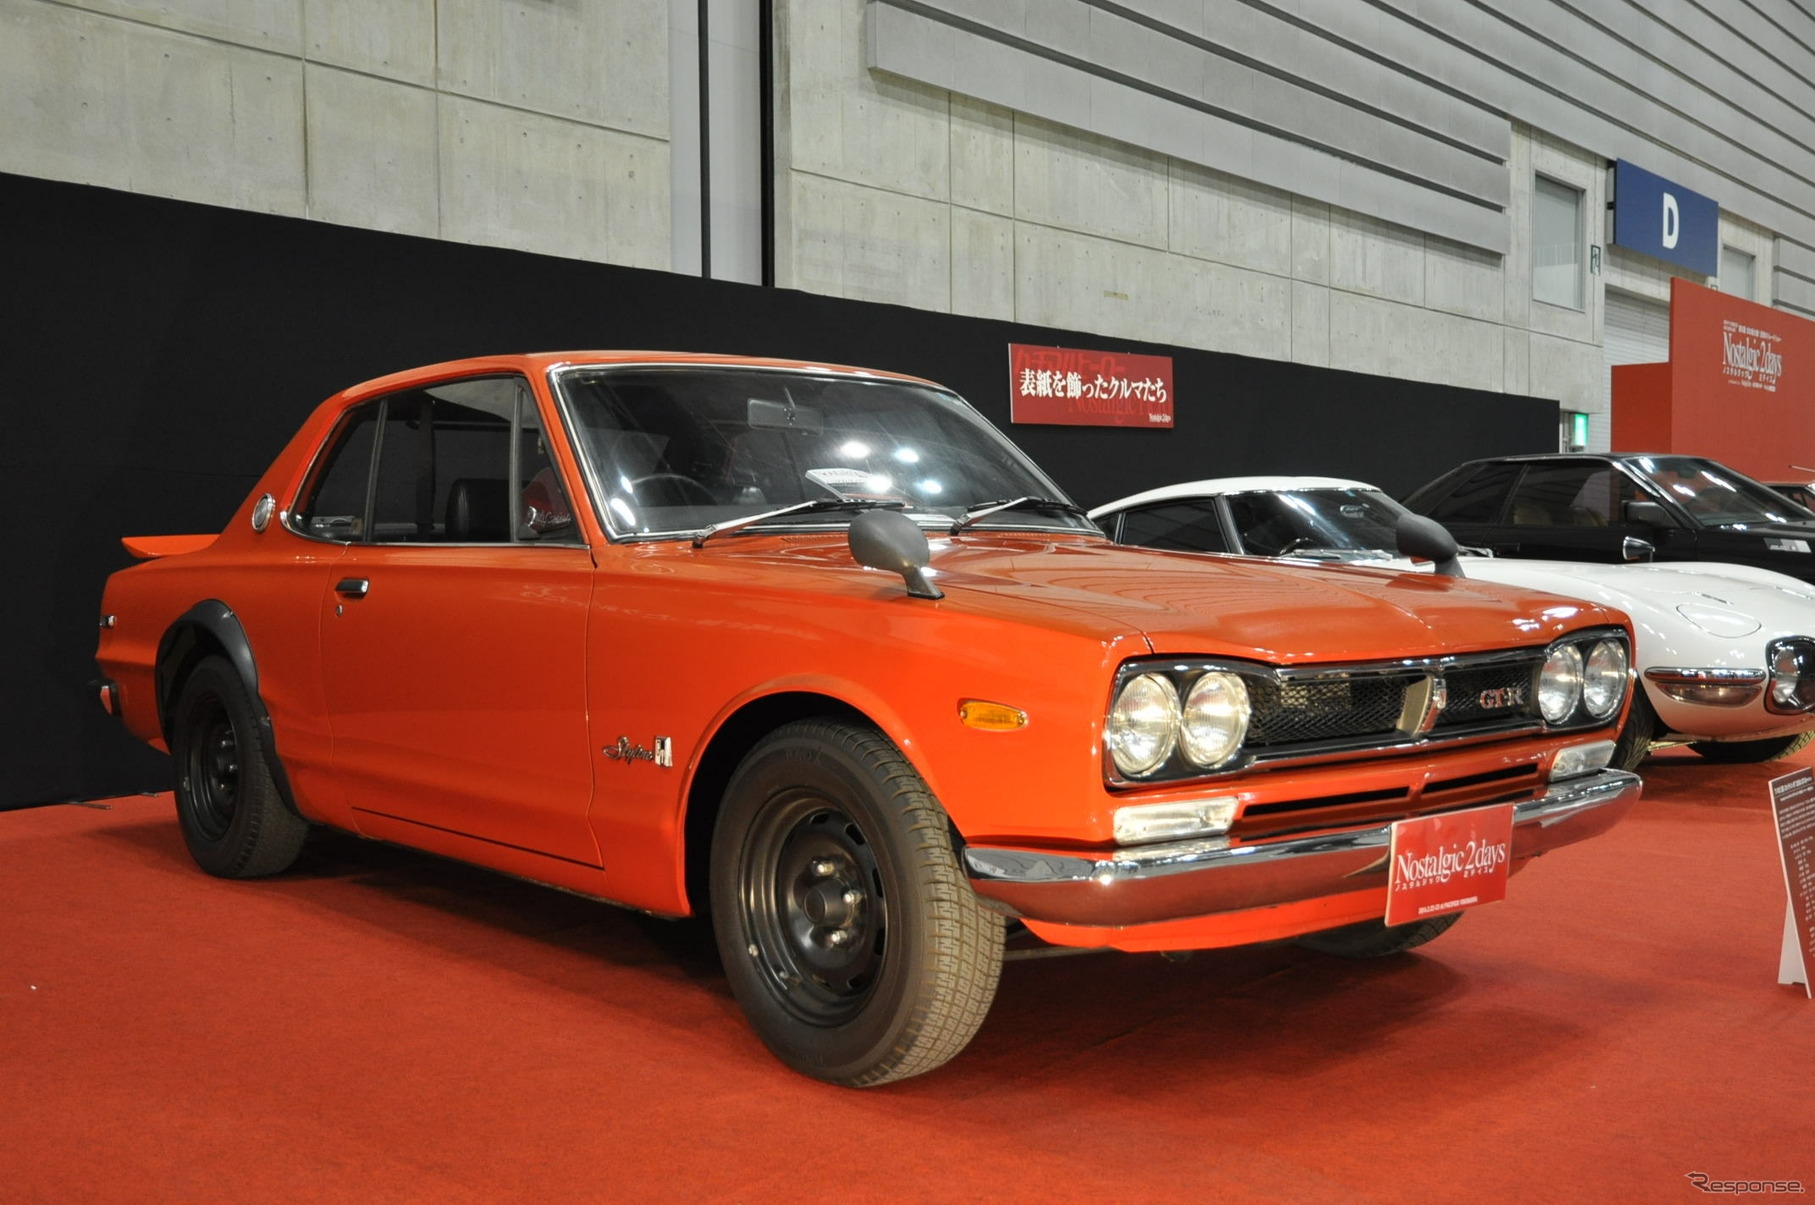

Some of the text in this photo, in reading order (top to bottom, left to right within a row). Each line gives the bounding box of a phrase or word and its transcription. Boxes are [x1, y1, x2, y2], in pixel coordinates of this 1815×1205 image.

[1662, 192, 1680, 250] D
[1722, 331, 1760, 380] Nostalgic
[1019, 367, 1168, 403] 表紙を飾ったクルマたち
[1395, 838, 1506, 883] Nostalgic 2days
